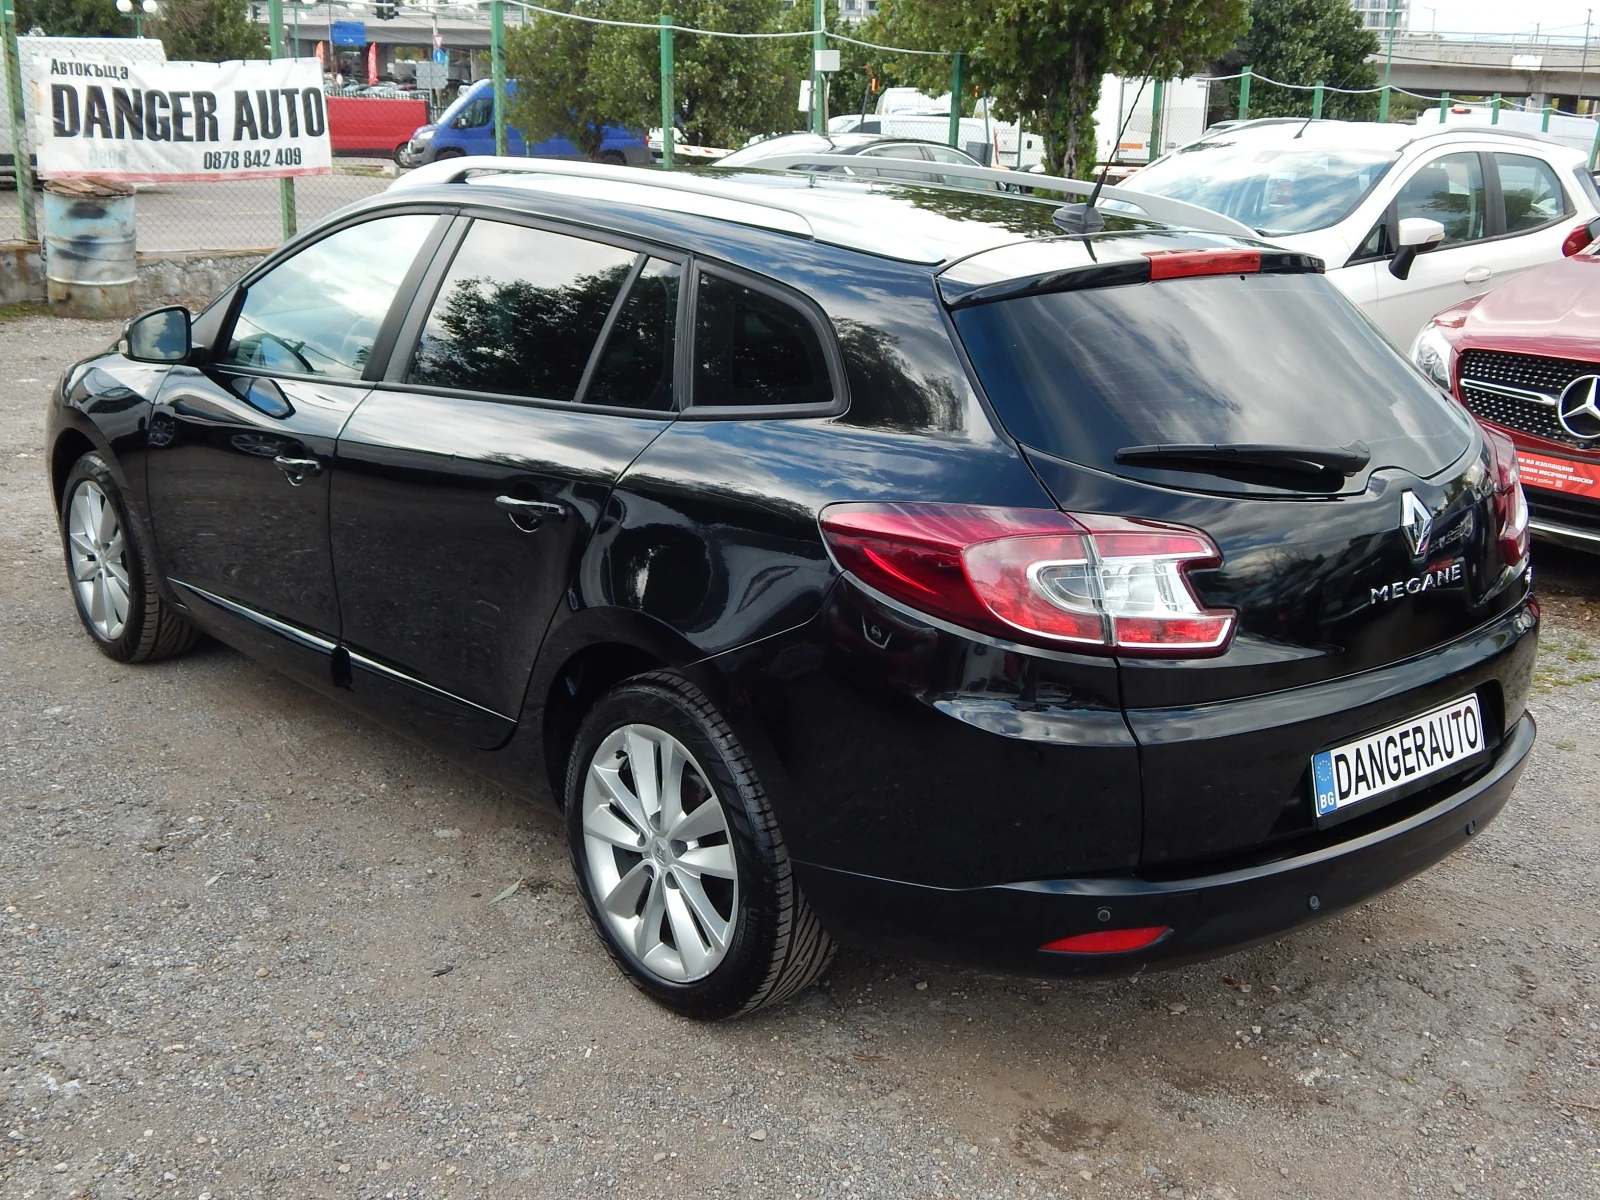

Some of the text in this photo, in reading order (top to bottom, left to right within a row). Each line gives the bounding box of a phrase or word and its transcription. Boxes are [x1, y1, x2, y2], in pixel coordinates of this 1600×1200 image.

[51, 83, 325, 142] DANGER AUTO
[203, 151, 239, 170] 0878
[243, 149, 270, 168] 842
[275, 147, 302, 166] 409
[1370, 563, 1461, 605] MEGANE
[1334, 705, 1478, 801] DANGERAUTO
[1319, 791, 1335, 809] BG
